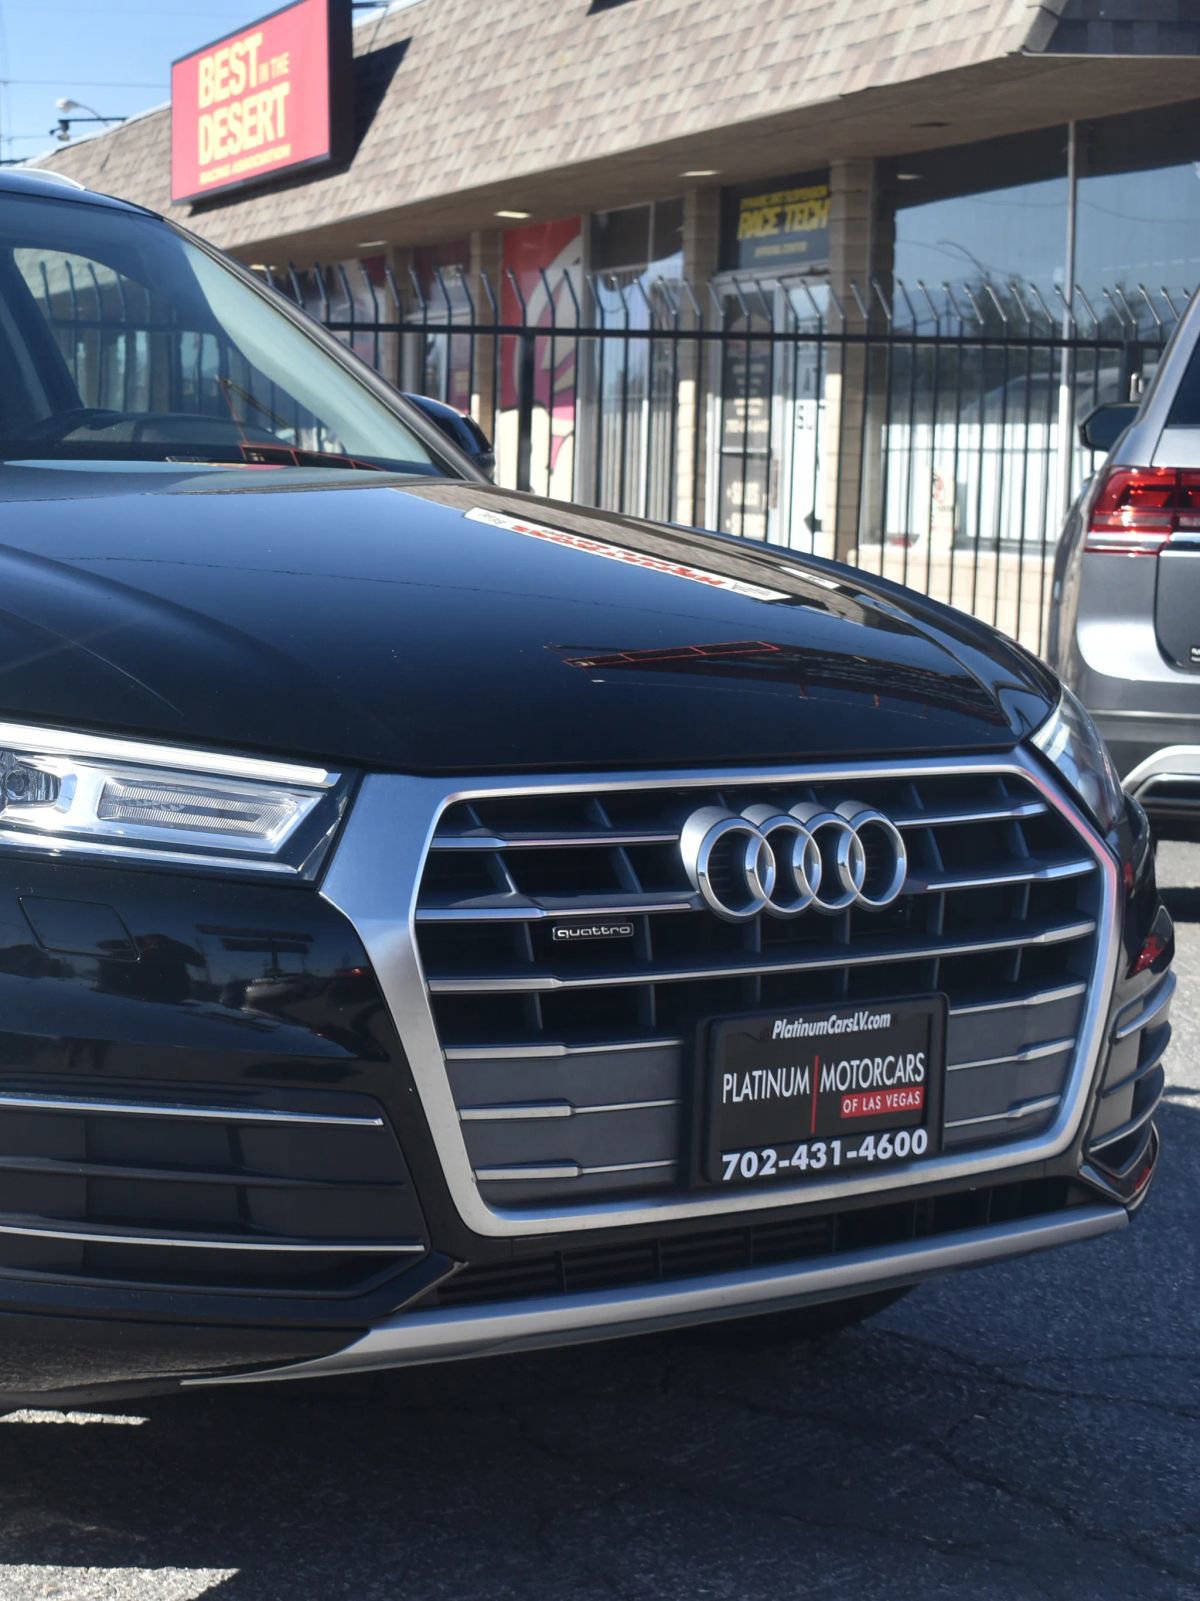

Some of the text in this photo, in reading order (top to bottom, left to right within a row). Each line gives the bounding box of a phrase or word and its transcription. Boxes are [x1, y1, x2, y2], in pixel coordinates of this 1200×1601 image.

[198, 32, 263, 109] BEST
[198, 81, 290, 166] DESERT
[557, 926, 630, 939] quattro
[772, 1011, 891, 1040] PlatinumCarsLV.com
[722, 1052, 925, 1104] PLATINUM MOTORCARS
[843, 1091, 921, 1114] OF LAS VEGAS
[722, 1129, 928, 1181] 702-431-4600
